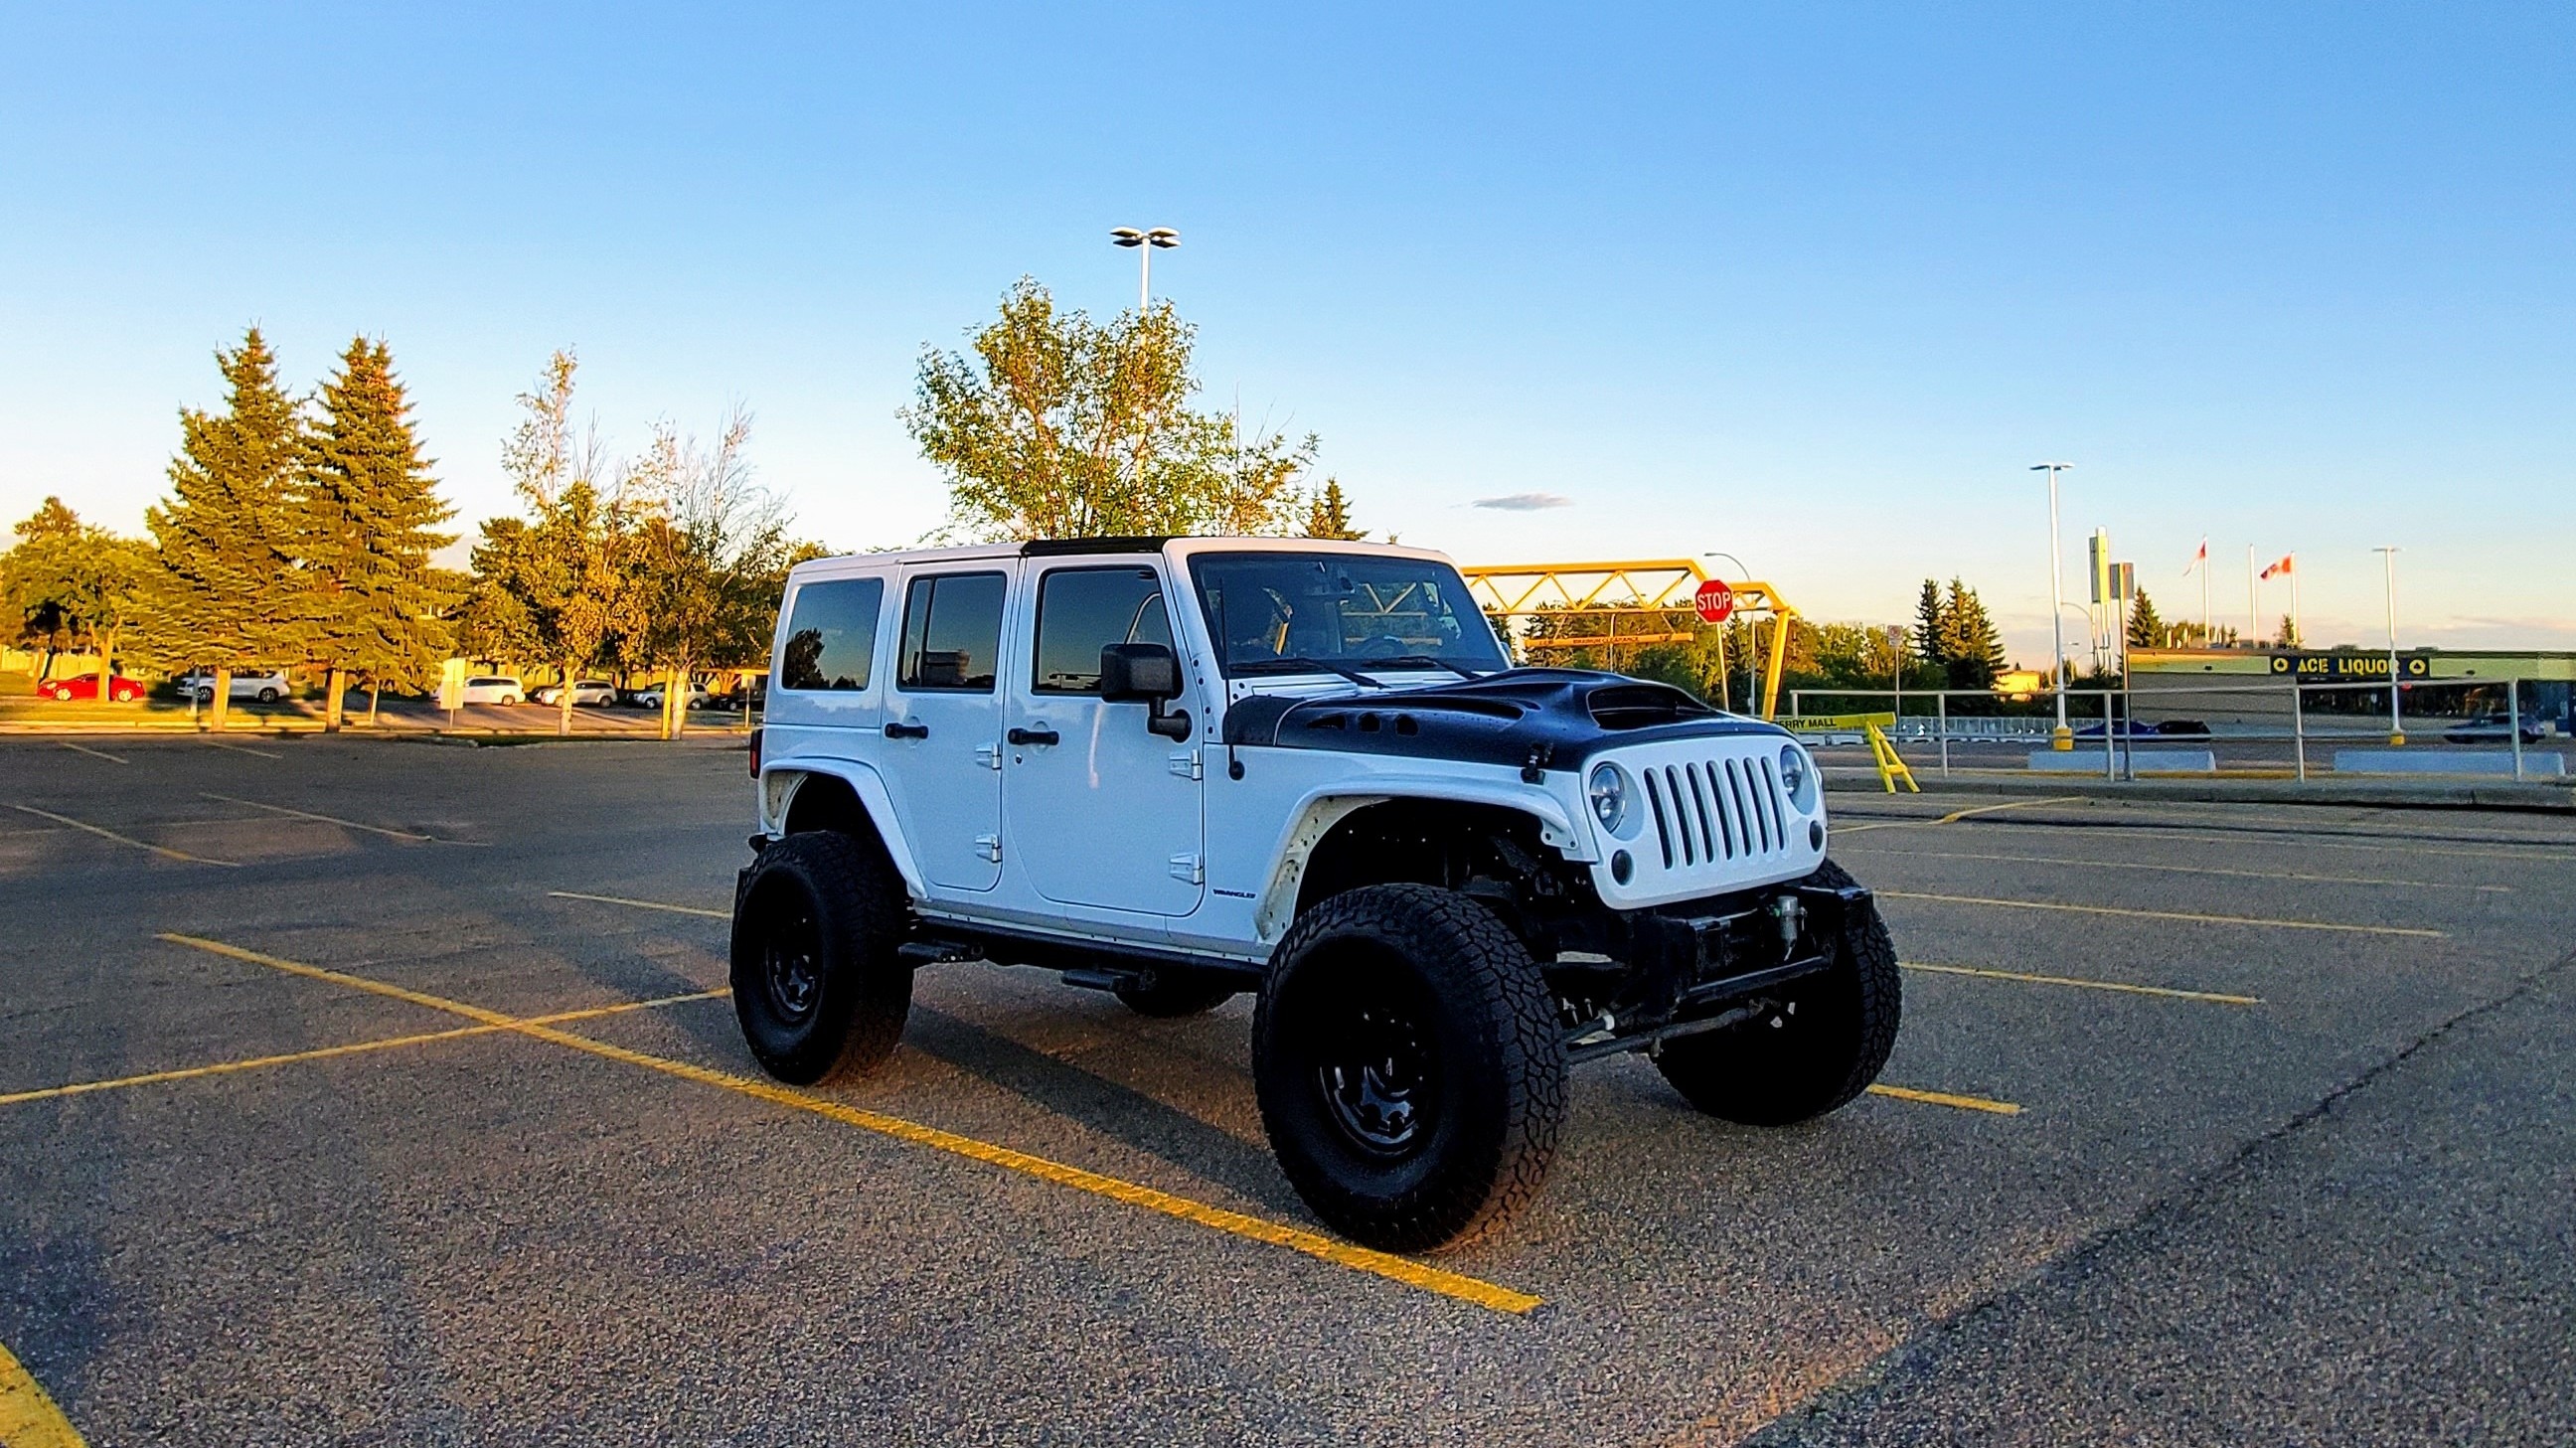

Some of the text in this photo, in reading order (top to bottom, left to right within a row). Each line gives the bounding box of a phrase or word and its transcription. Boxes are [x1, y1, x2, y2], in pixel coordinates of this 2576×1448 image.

[1697, 591, 1731, 611] STOP
[2298, 658, 2400, 676] ACE LIQUOR
[1776, 718, 1837, 729] ERRY MALL
